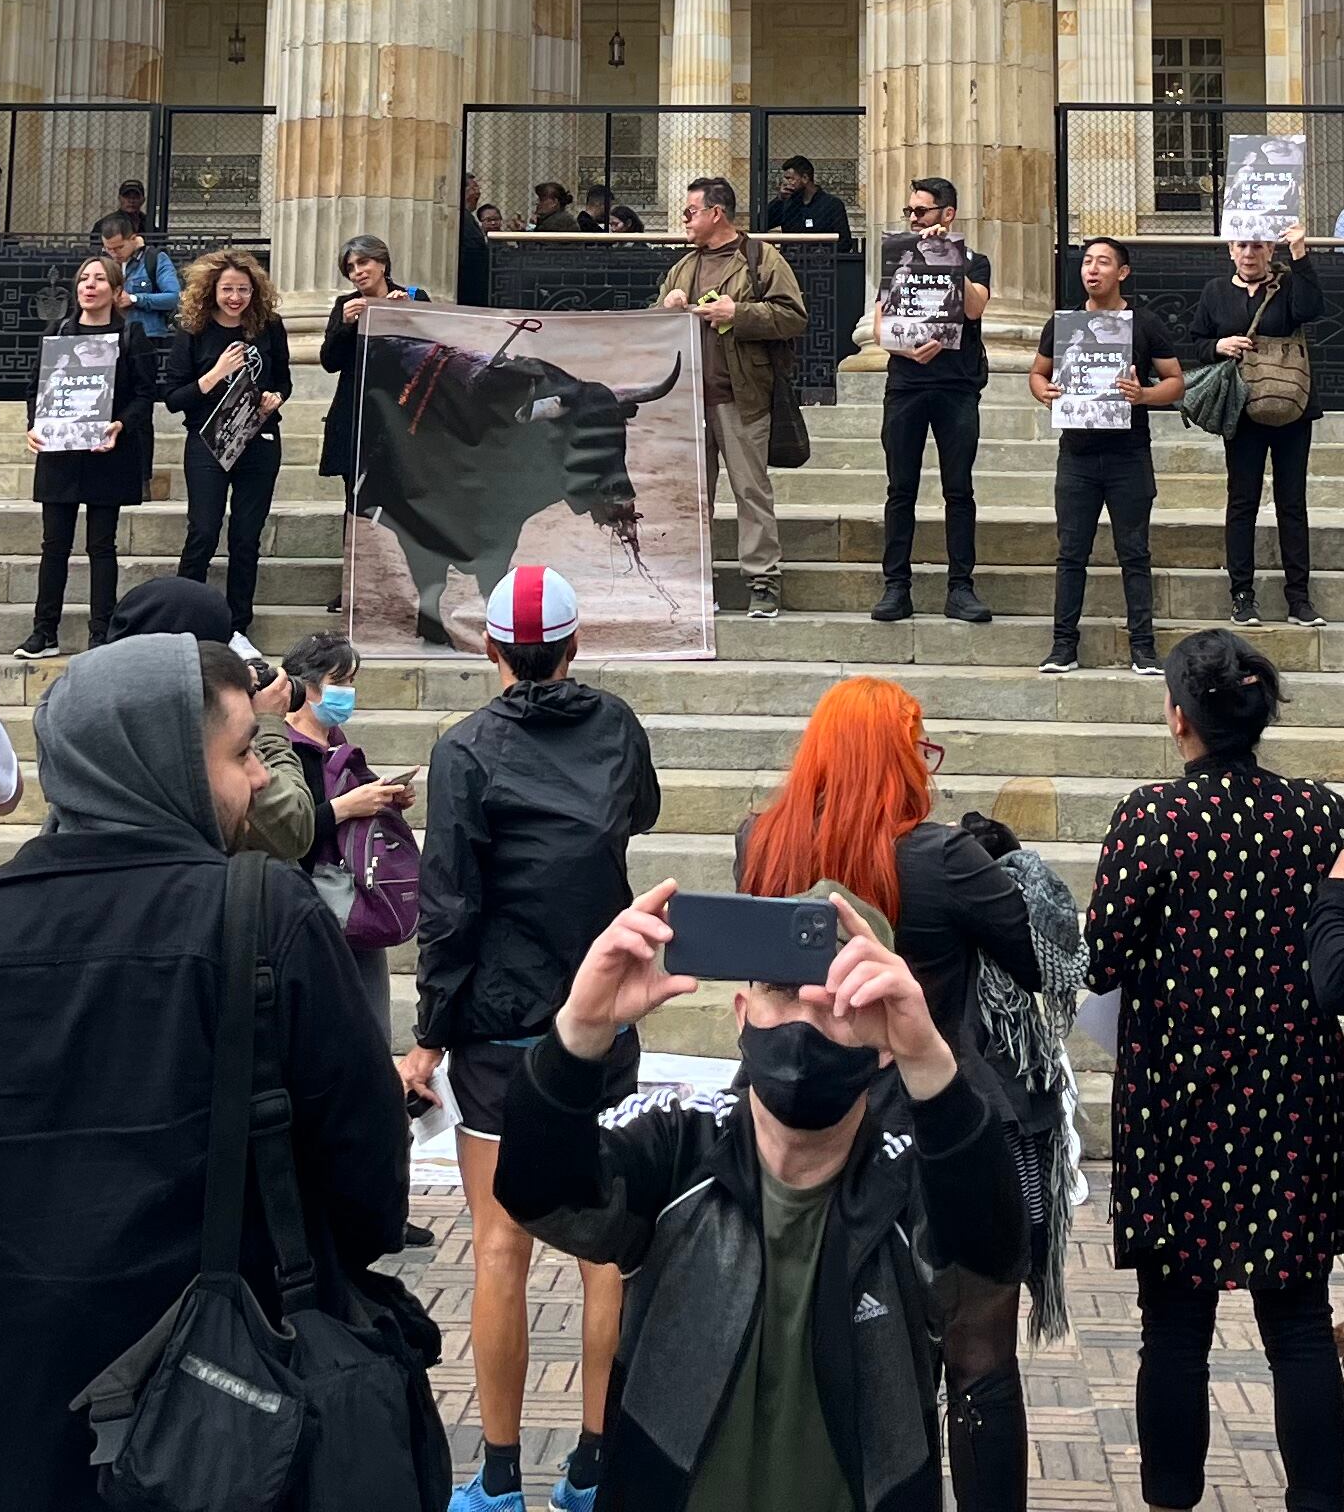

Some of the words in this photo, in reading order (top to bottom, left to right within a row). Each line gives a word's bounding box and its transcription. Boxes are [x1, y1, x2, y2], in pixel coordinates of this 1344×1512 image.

[896, 274, 905, 284] SI
[907, 274, 921, 284] AL
[922, 274, 935, 284] PL
[937, 274, 951, 285] 85
[1078, 353, 1091, 362] AL
[1093, 353, 1107, 362] PL
[1108, 353, 1123, 363] 85
[61, 377, 75, 386] AL
[77, 376, 89, 385] PL
[91, 375, 105, 385] 85
